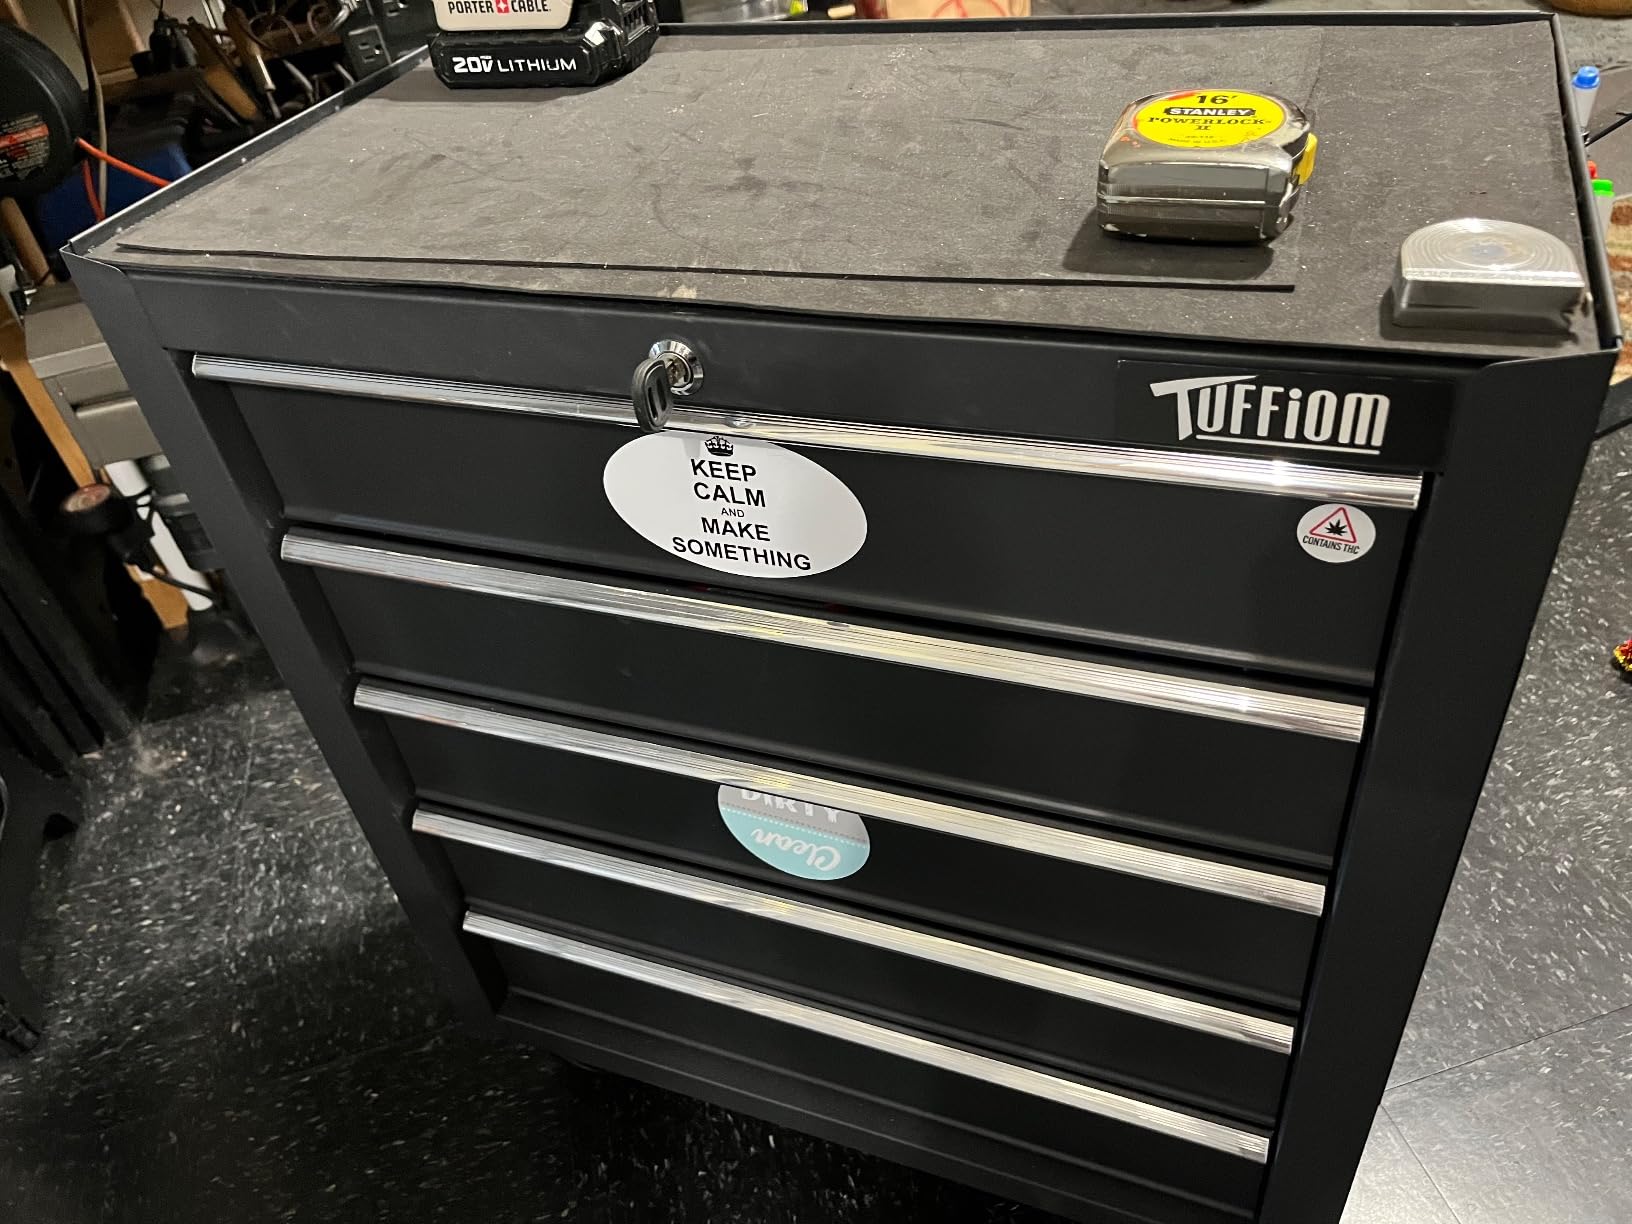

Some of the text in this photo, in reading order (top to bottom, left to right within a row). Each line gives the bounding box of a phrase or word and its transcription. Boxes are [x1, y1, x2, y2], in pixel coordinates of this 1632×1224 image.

[448, 0, 549, 14] PORTER CABLE
[497, 58, 577, 72] LITHIUM
[1147, 116, 1265, 125] POWERLOCK
[1168, 107, 1252, 116] STANLEY
[690, 458, 757, 482] KEEP
[693, 481, 767, 508] CALM
[720, 507, 745, 518] AND
[700, 516, 772, 542] MAKE
[671, 536, 812, 571] SOMETHING
[1302, 535, 1361, 555] CONTAINS THC
[750, 828, 842, 872] Clean
